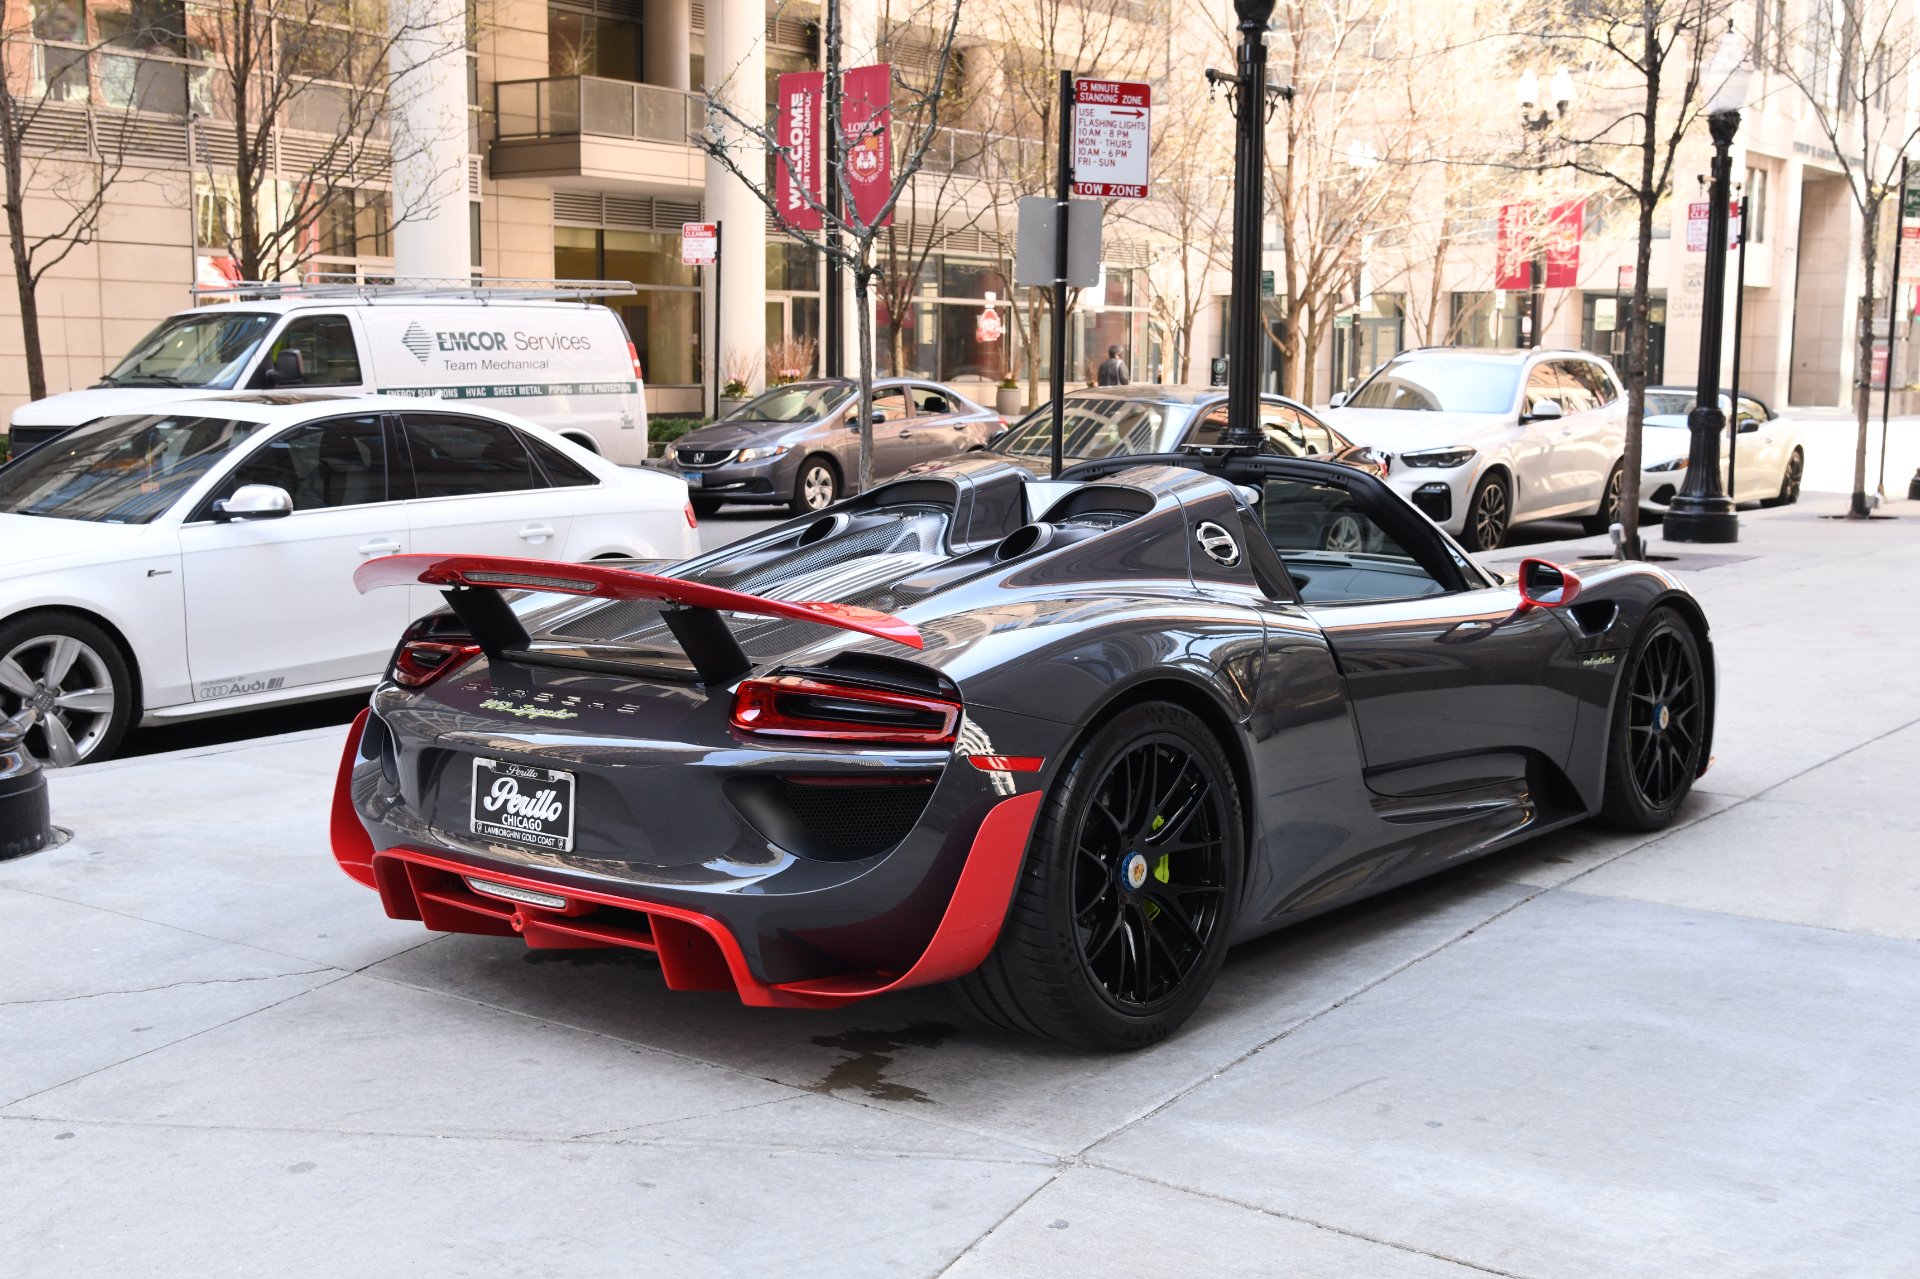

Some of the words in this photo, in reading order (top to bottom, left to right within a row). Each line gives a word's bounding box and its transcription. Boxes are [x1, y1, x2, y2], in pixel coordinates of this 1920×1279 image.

[1080, 82, 1088, 91] 15
[1090, 84, 1119, 93] MINUTE
[1080, 92, 1118, 103] STANDING
[1122, 96, 1142, 105] ZONE
[1079, 108, 1095, 117] USE
[847, 121, 884, 133] LOYOLA
[1079, 118, 1118, 129] FLASHING
[1119, 121, 1146, 131] LIGHTS
[1078, 128, 1088, 136] 10
[1089, 128, 1101, 137] AM
[1117, 131, 1129, 139] PM
[1078, 138, 1096, 146] MON
[1106, 140, 1132, 149] THURS
[789, 93, 804, 210] WELCOME
[1078, 148, 1086, 156] 10
[1088, 148, 1100, 157] AM
[804, 143, 812, 175] TOWER
[1078, 157, 1091, 166] FRI
[1099, 159, 1115, 167] SUN
[1078, 183, 1103, 195] TOW
[1109, 186, 1142, 197] ZONE
[436, 331, 509, 351] EMCOR
[514, 331, 591, 350] Services
[444, 359, 478, 371] Team
[481, 359, 549, 370] Mechanical
[417, 387, 459, 398] SOLUONS
[465, 387, 487, 397] HVAC
[493, 386, 516, 396] SHEET
[519, 385, 542, 395] METAL
[549, 384, 572, 394] PIPING
[579, 384, 593, 393] FIRE
[594, 383, 631, 393] PROTECTION
[229, 680, 265, 694] Audi
[506, 764, 538, 778] Perillo
[483, 776, 562, 822] Perillo
[502, 814, 542, 831] CHICAGO
[484, 825, 520, 840] LAMBORGHINI
[521, 833, 536, 843] GOLD
[537, 836, 556, 846] COAST
